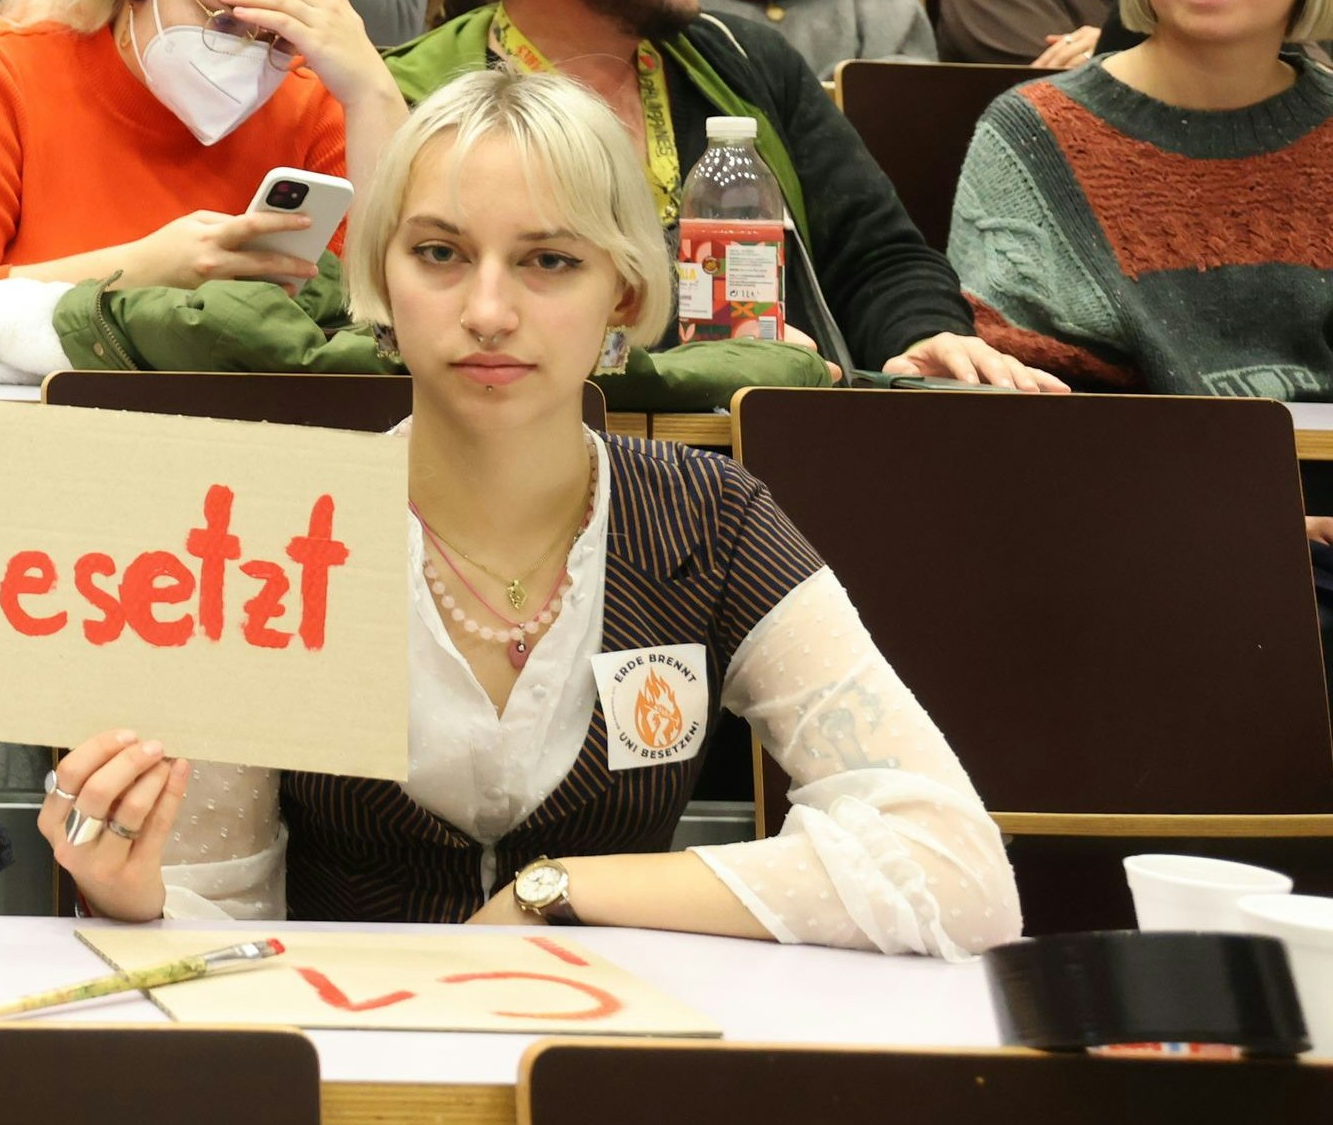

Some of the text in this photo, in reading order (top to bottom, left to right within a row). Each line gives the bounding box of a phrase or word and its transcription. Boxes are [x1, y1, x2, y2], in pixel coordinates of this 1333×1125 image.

[614, 653, 697, 683] ERDE BRENNT
[619, 720, 700, 760] UNI BESETZEN!
[293, 966, 626, 1022] C1
